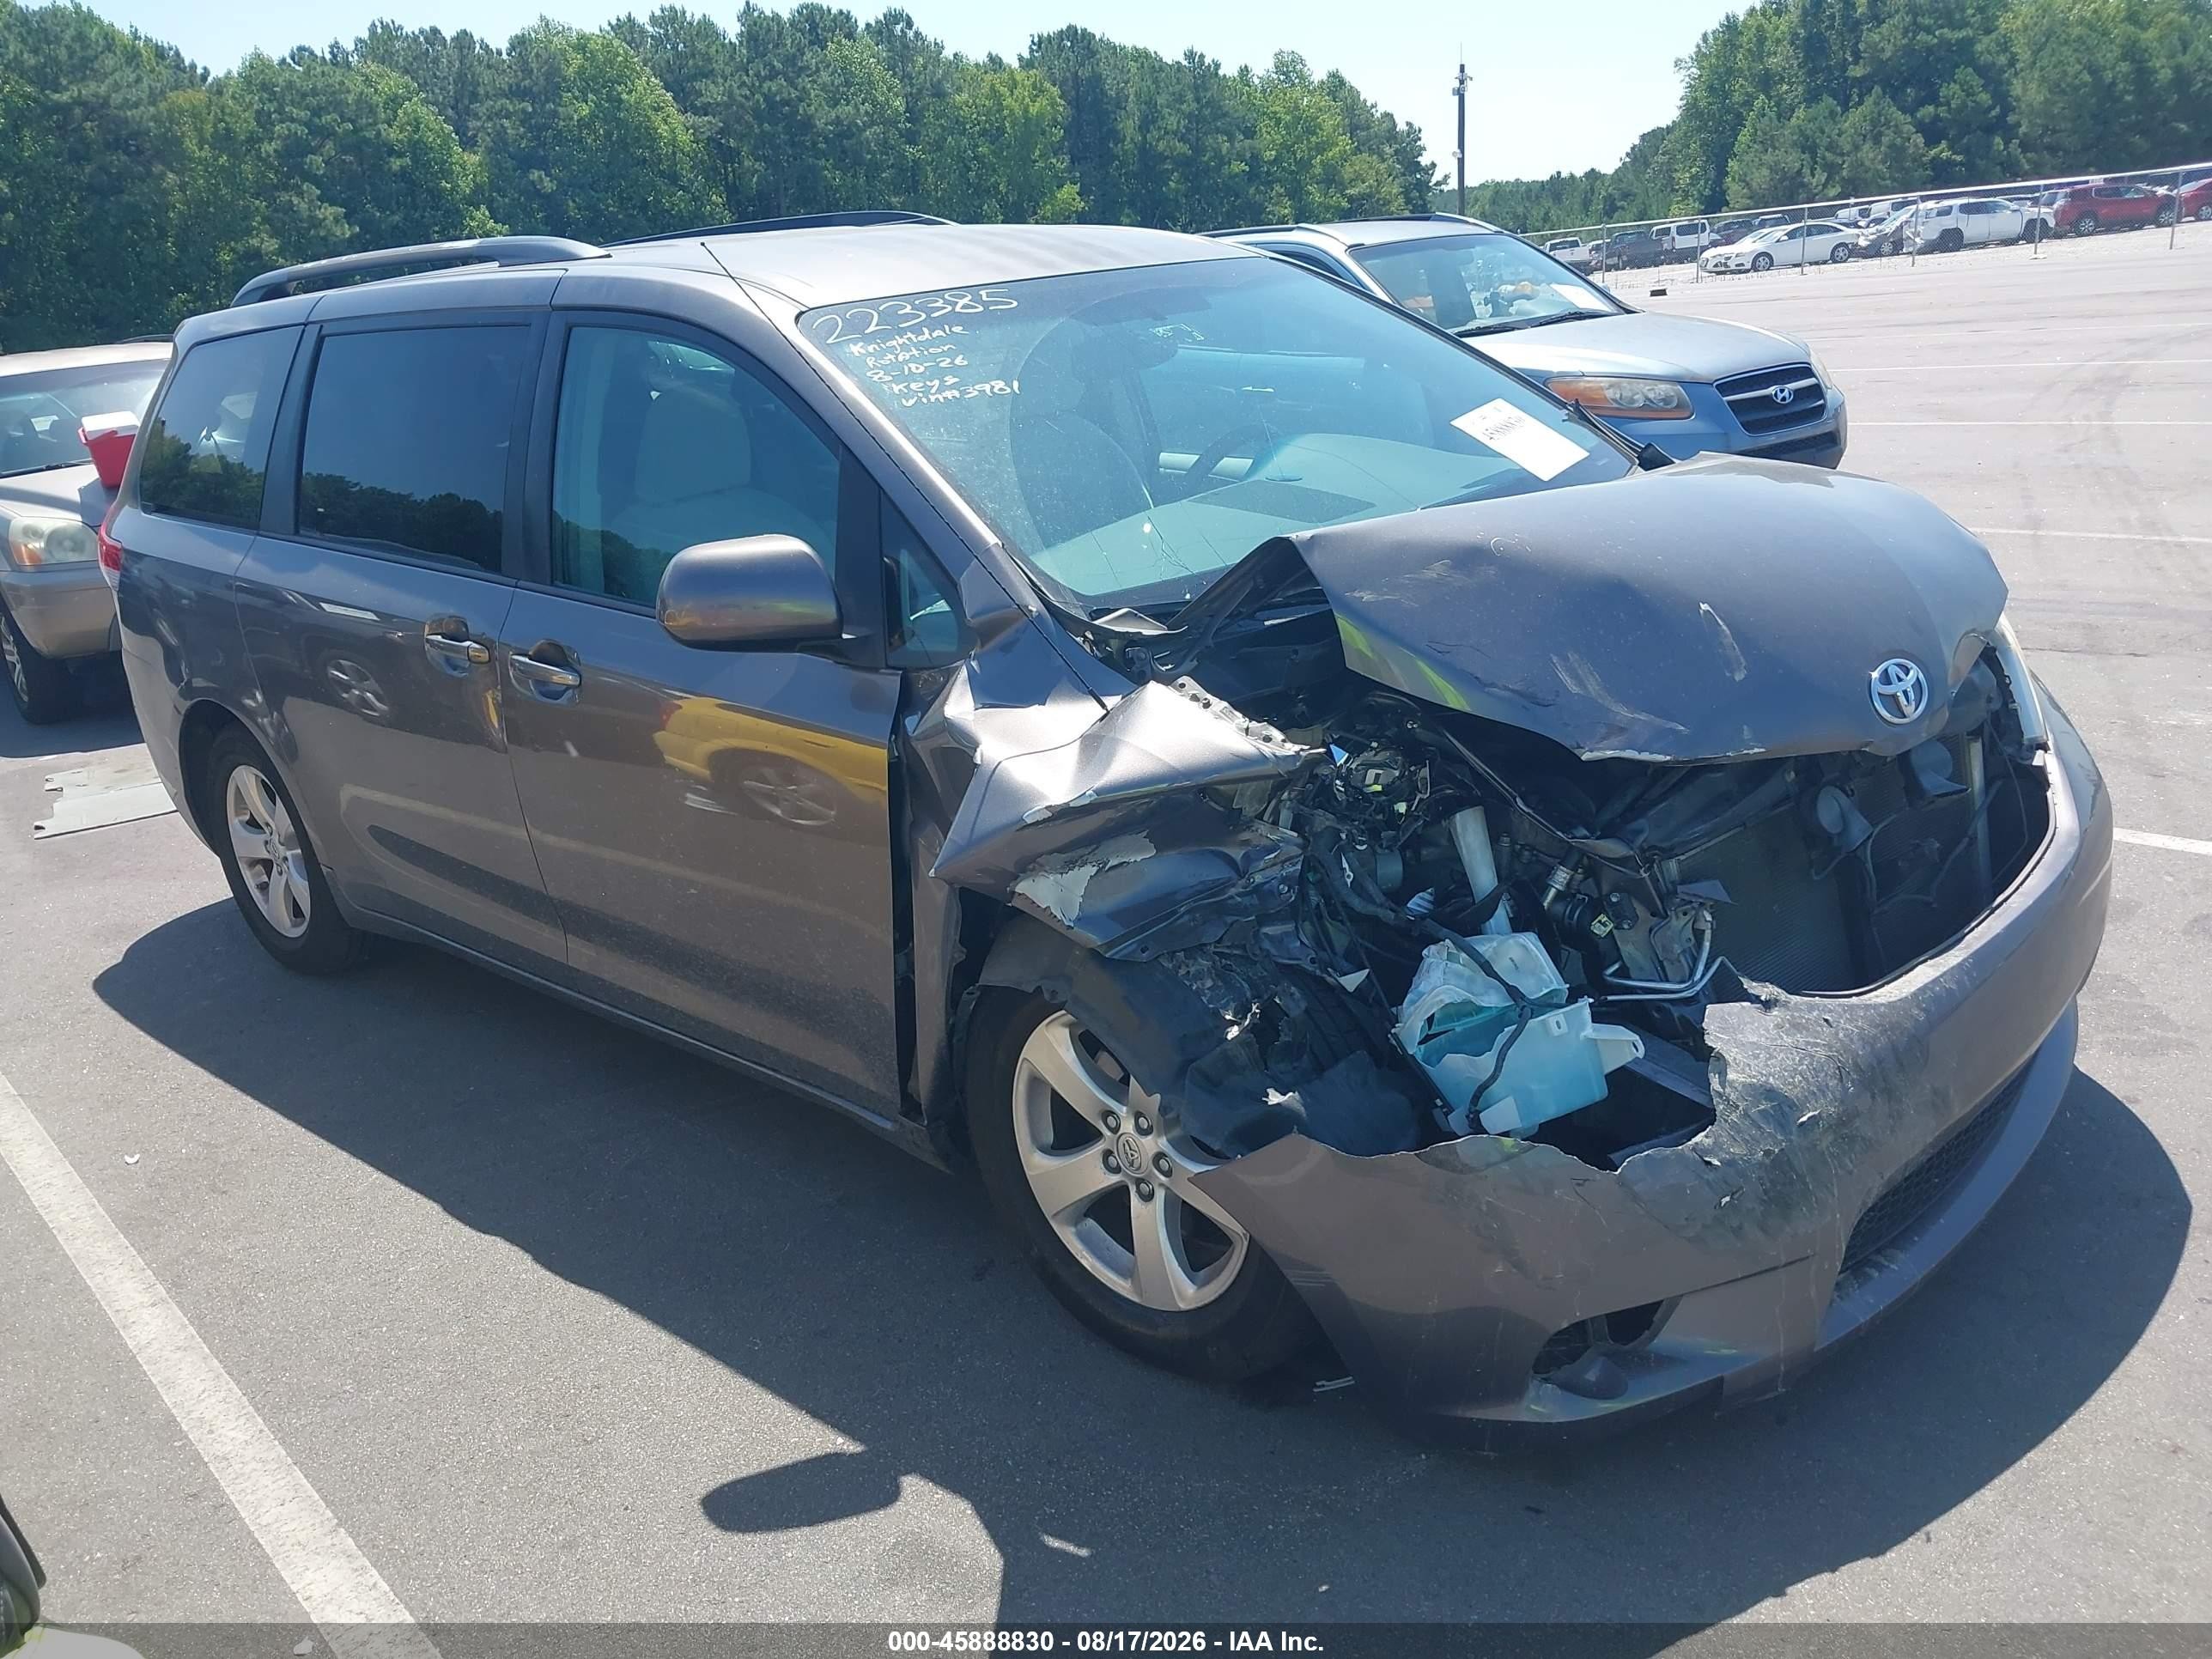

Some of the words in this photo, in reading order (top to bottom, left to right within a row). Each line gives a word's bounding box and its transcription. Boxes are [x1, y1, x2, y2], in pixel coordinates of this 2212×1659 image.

[812, 289, 1018, 344] 223385
[848, 325, 969, 357] Knightdale
[866, 355, 969, 383] 8-10-26
